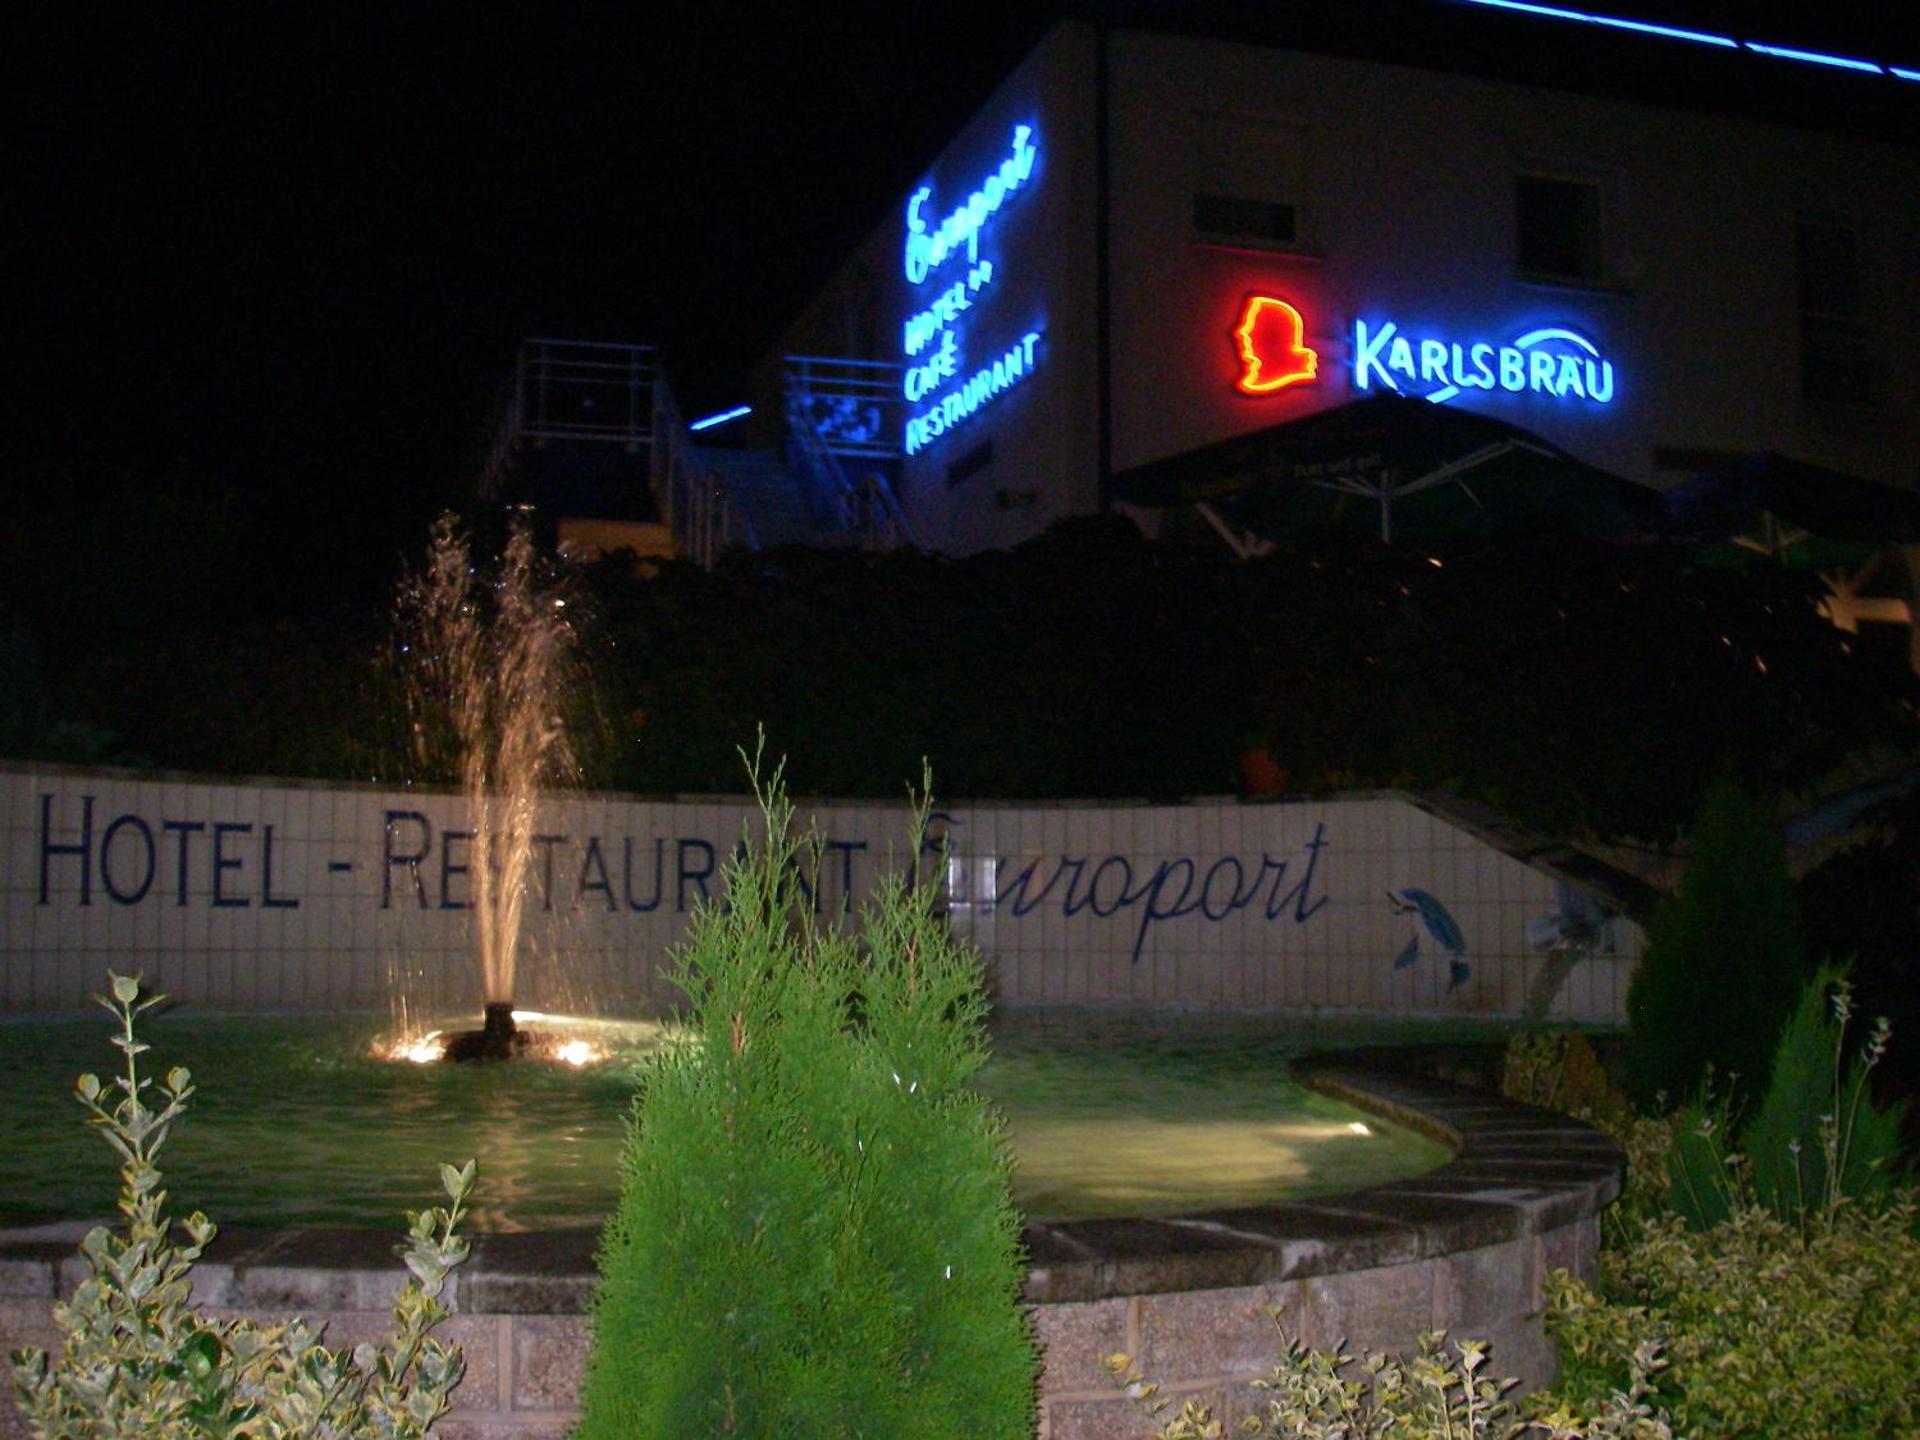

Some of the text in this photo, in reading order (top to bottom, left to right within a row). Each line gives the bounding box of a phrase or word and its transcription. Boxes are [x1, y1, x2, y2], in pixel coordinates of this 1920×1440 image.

[904, 331, 1041, 456] RESTAURANT
[1354, 317, 1615, 404] KARLSBRÄU
[38, 793, 299, 909] HOTEL
[379, 809, 867, 914] RETAURNT
